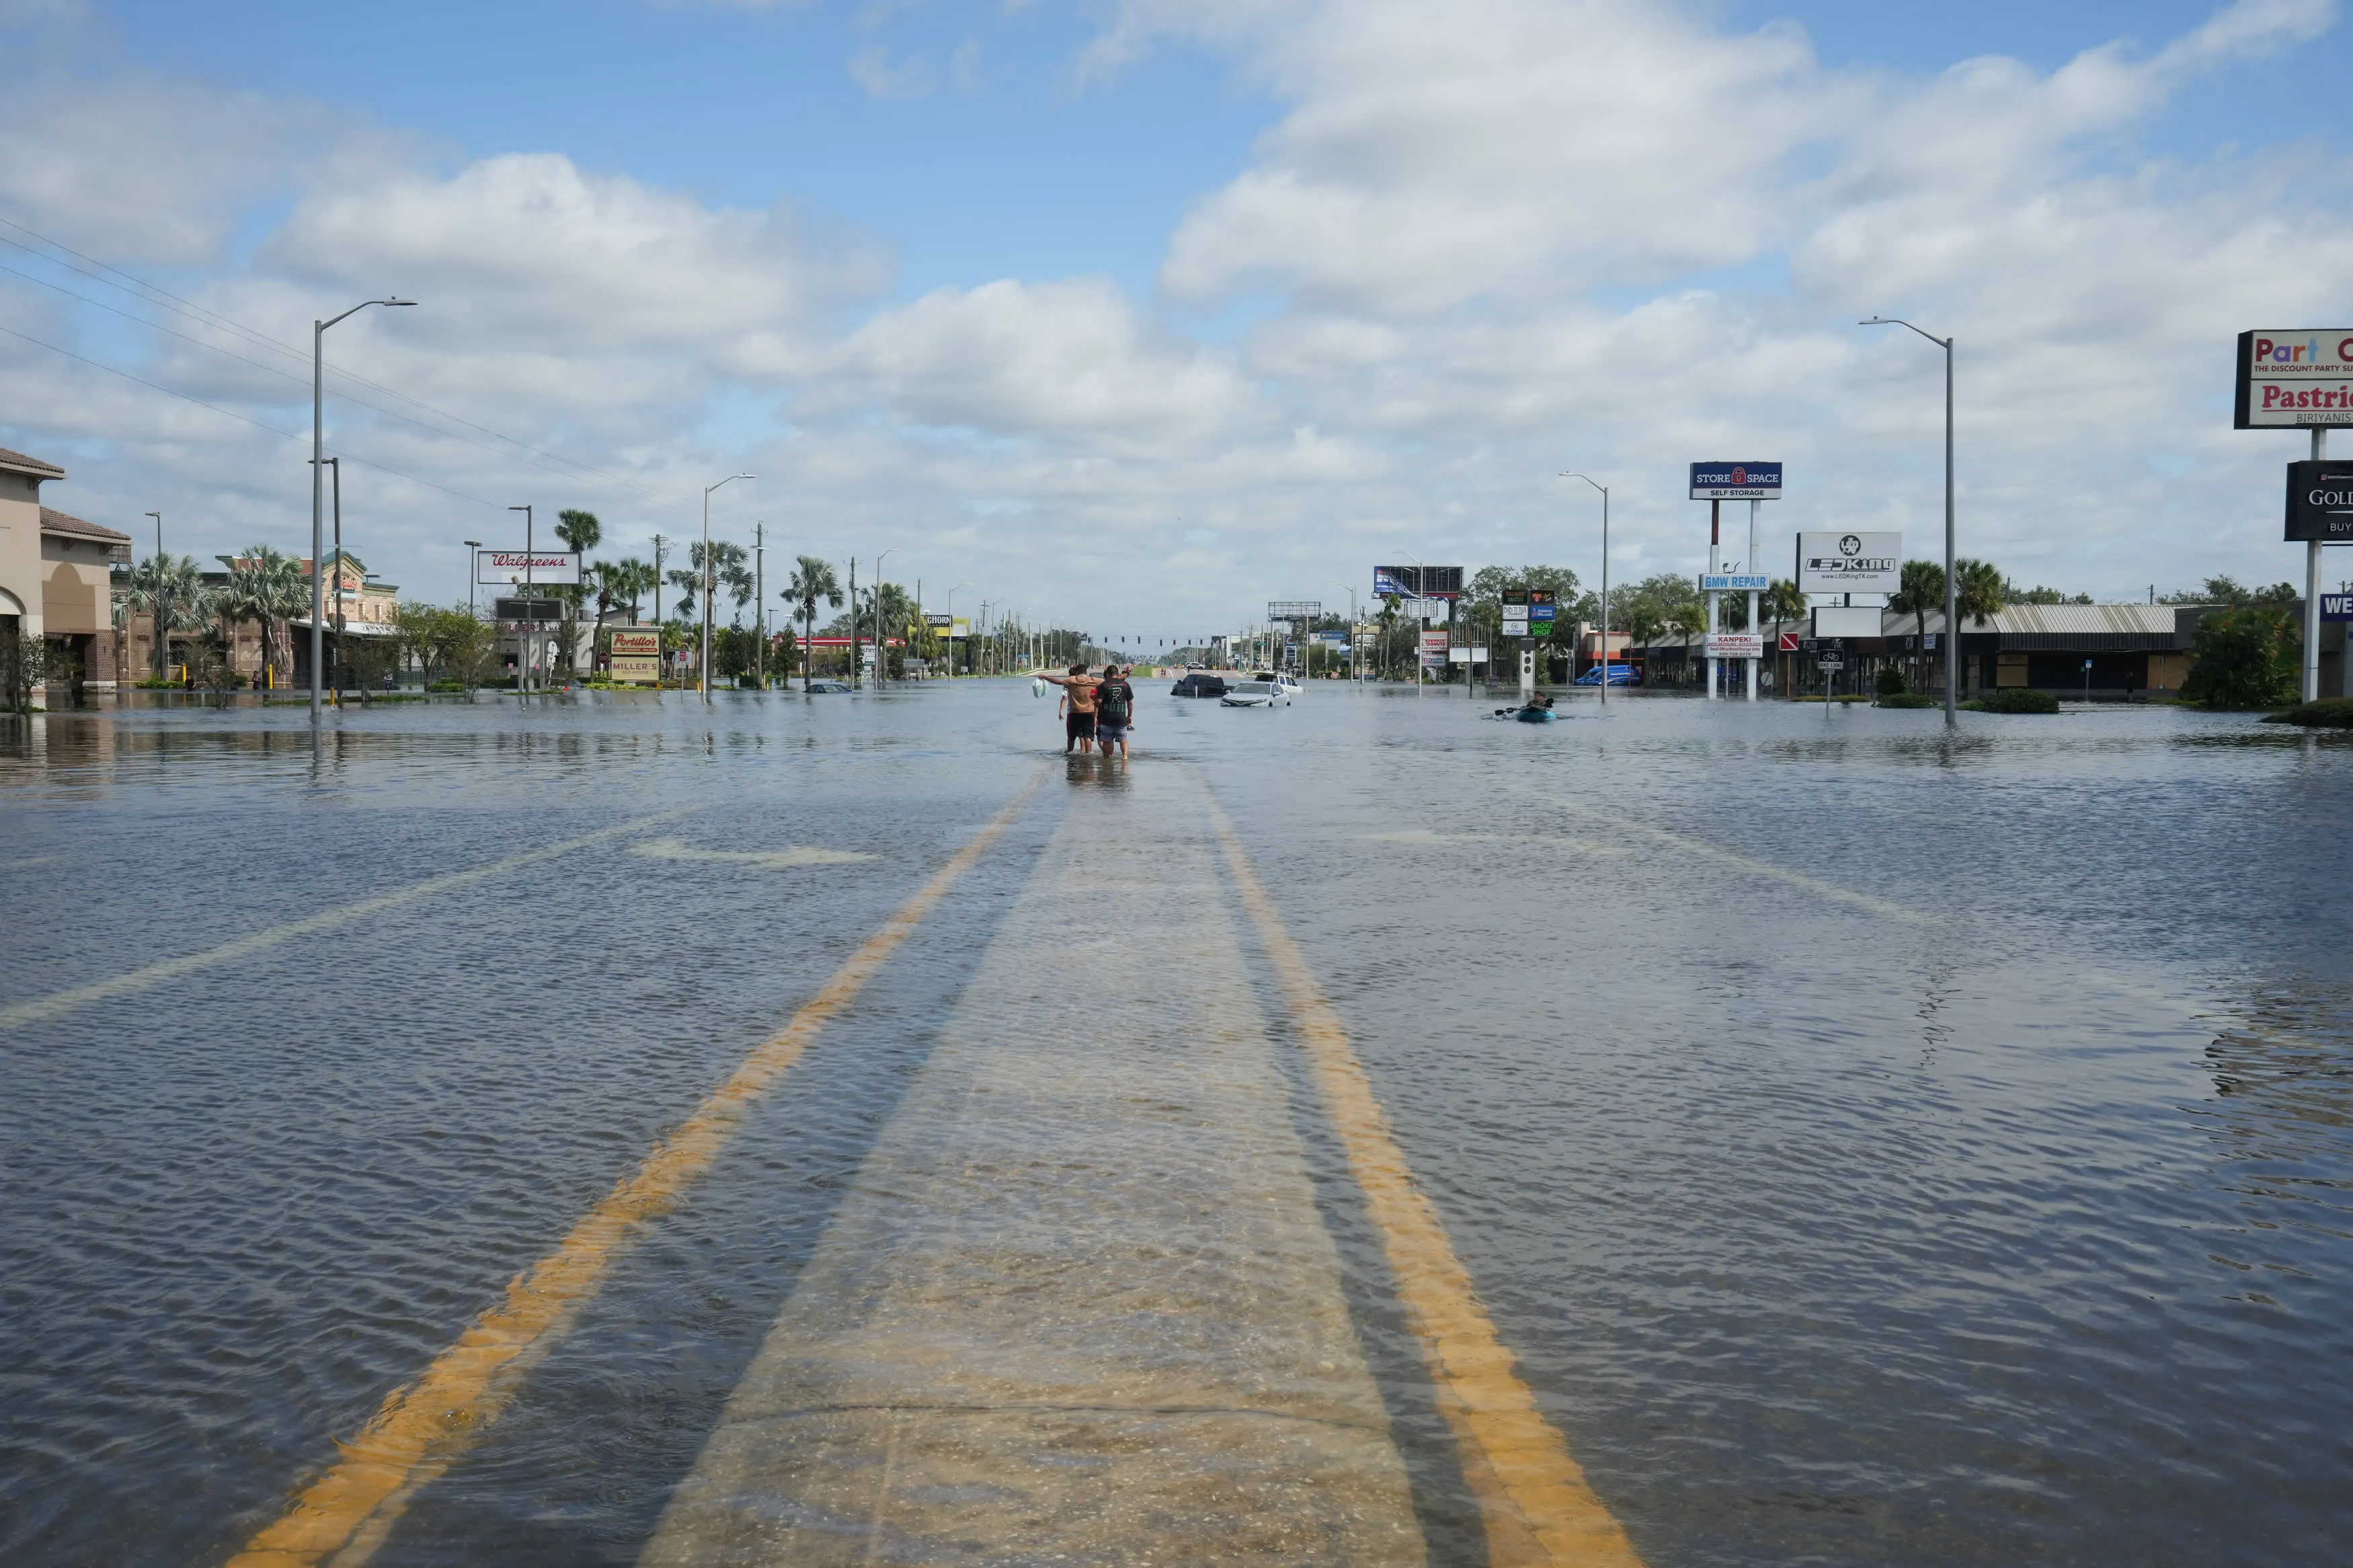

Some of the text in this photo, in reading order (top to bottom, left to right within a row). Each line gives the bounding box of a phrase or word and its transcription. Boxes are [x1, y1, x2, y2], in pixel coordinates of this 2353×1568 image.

[2256, 338, 2319, 362] Part
[2262, 385, 2353, 408] Pastri
[1696, 474, 1779, 483] STORE SPACE
[2330, 523, 2352, 532] BUY
[491, 553, 567, 570] Walgreens
[1705, 577, 1766, 587] BMW REPAIR
[928, 616, 950, 624] GHORN
[613, 634, 656, 646] Portillo's
